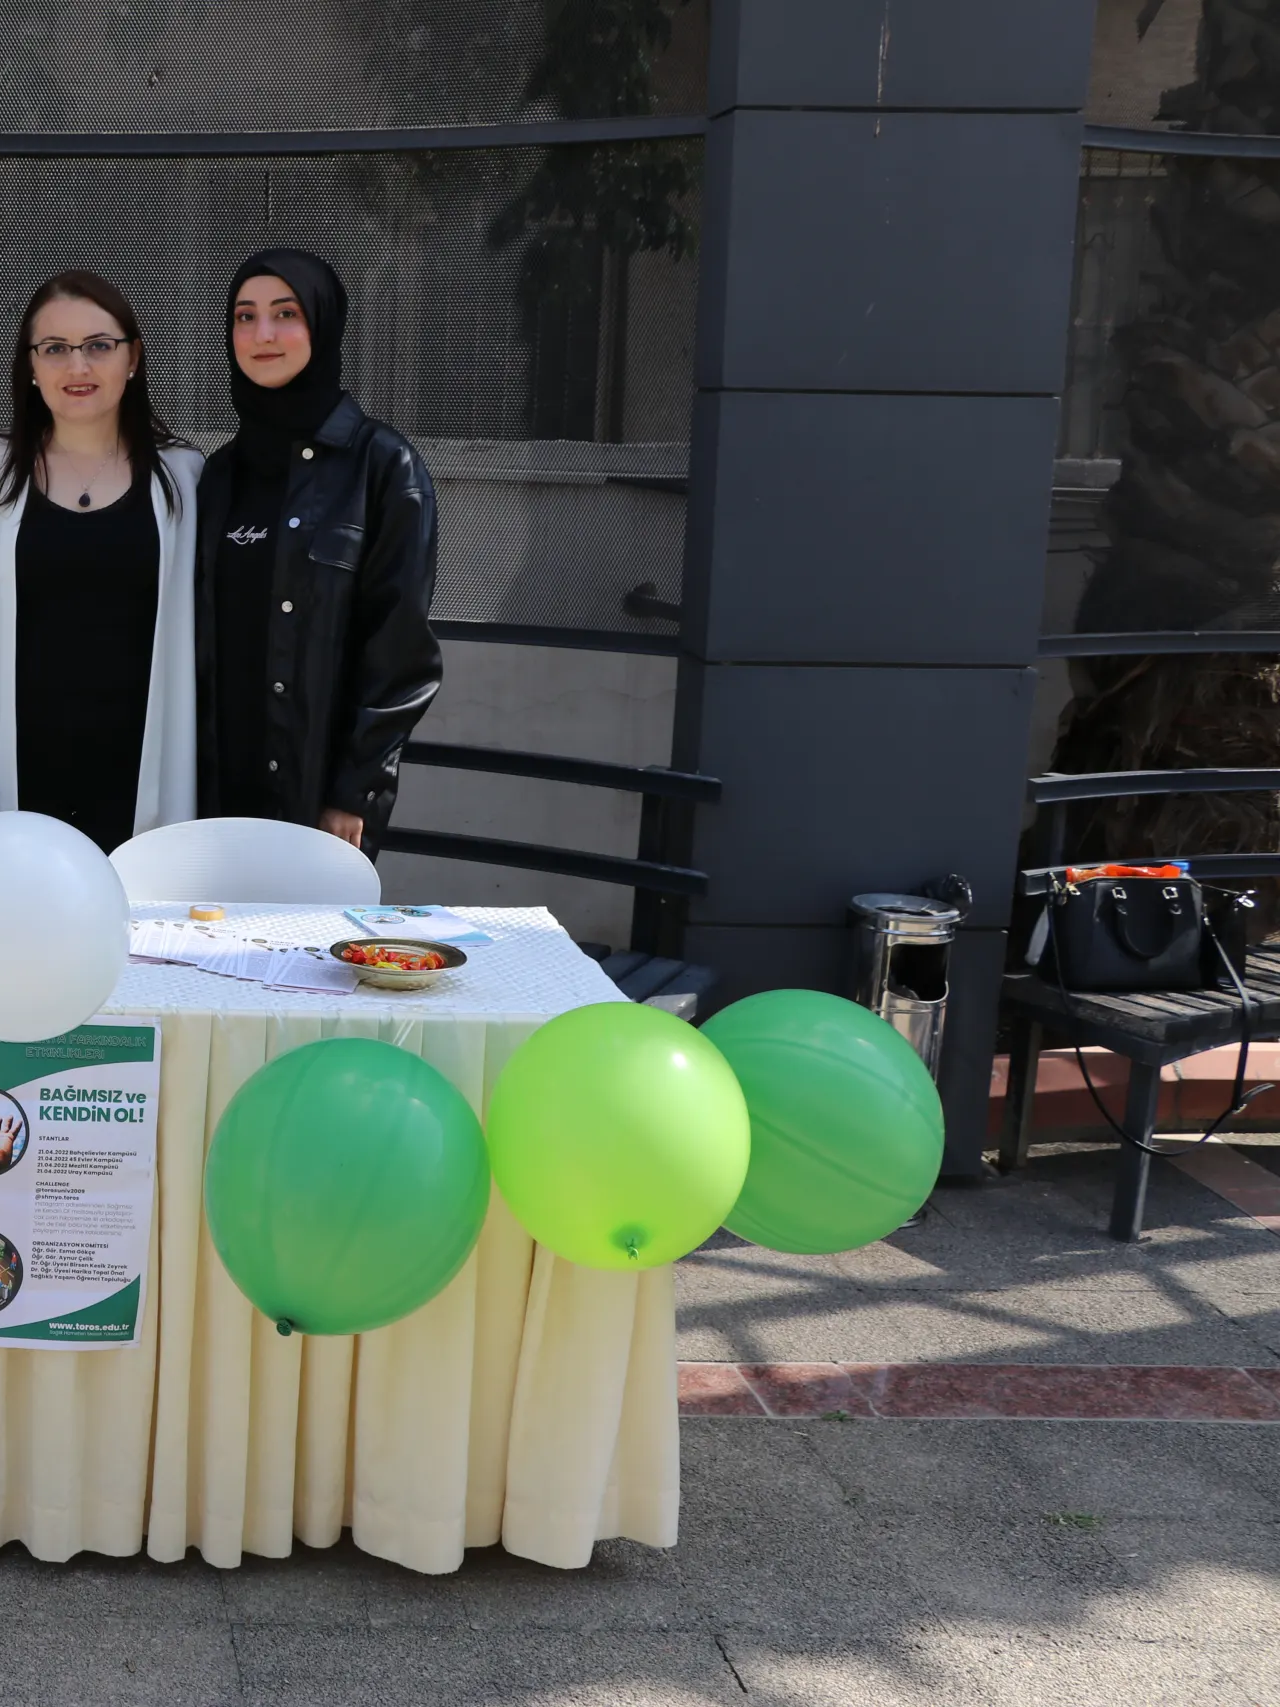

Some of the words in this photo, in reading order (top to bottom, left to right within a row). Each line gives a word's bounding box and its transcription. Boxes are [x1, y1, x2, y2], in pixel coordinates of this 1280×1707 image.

[39, 1085, 123, 1103] BAĞIMSIZ
[125, 1092, 147, 1104] ve
[113, 1107, 144, 1123] OL!
[49, 1322, 130, 1331] www.toros.edu.tr
